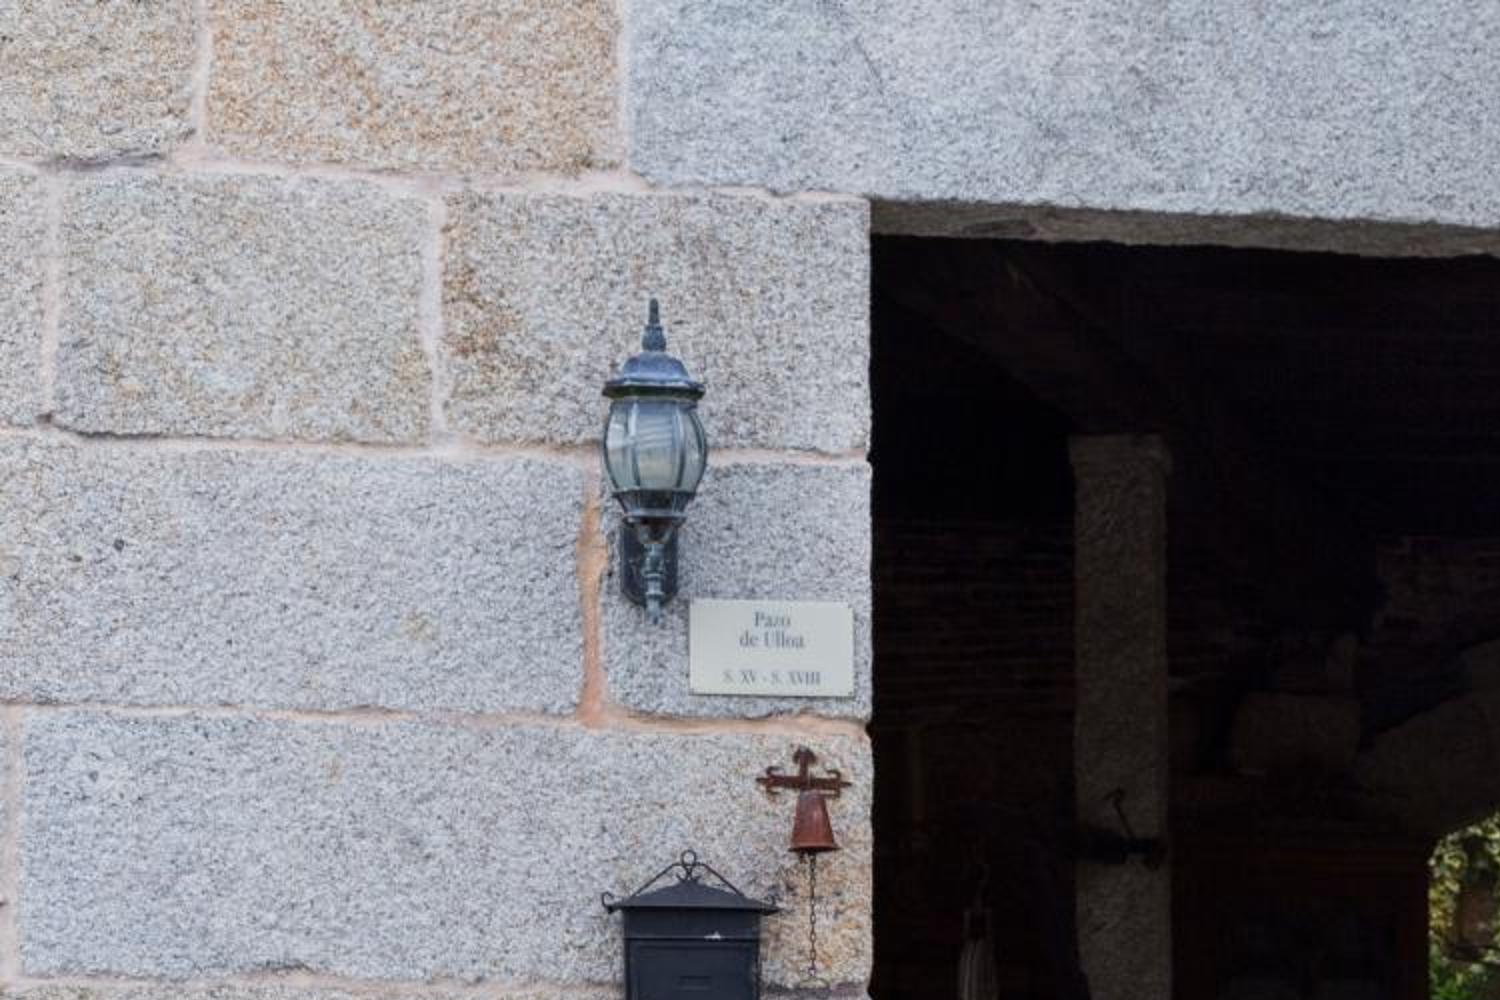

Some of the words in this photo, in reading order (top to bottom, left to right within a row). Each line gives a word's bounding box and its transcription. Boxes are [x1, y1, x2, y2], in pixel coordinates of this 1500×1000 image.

[754, 611, 791, 628] Pazo
[739, 630, 759, 648] de
[764, 630, 805, 649] Ulloa
